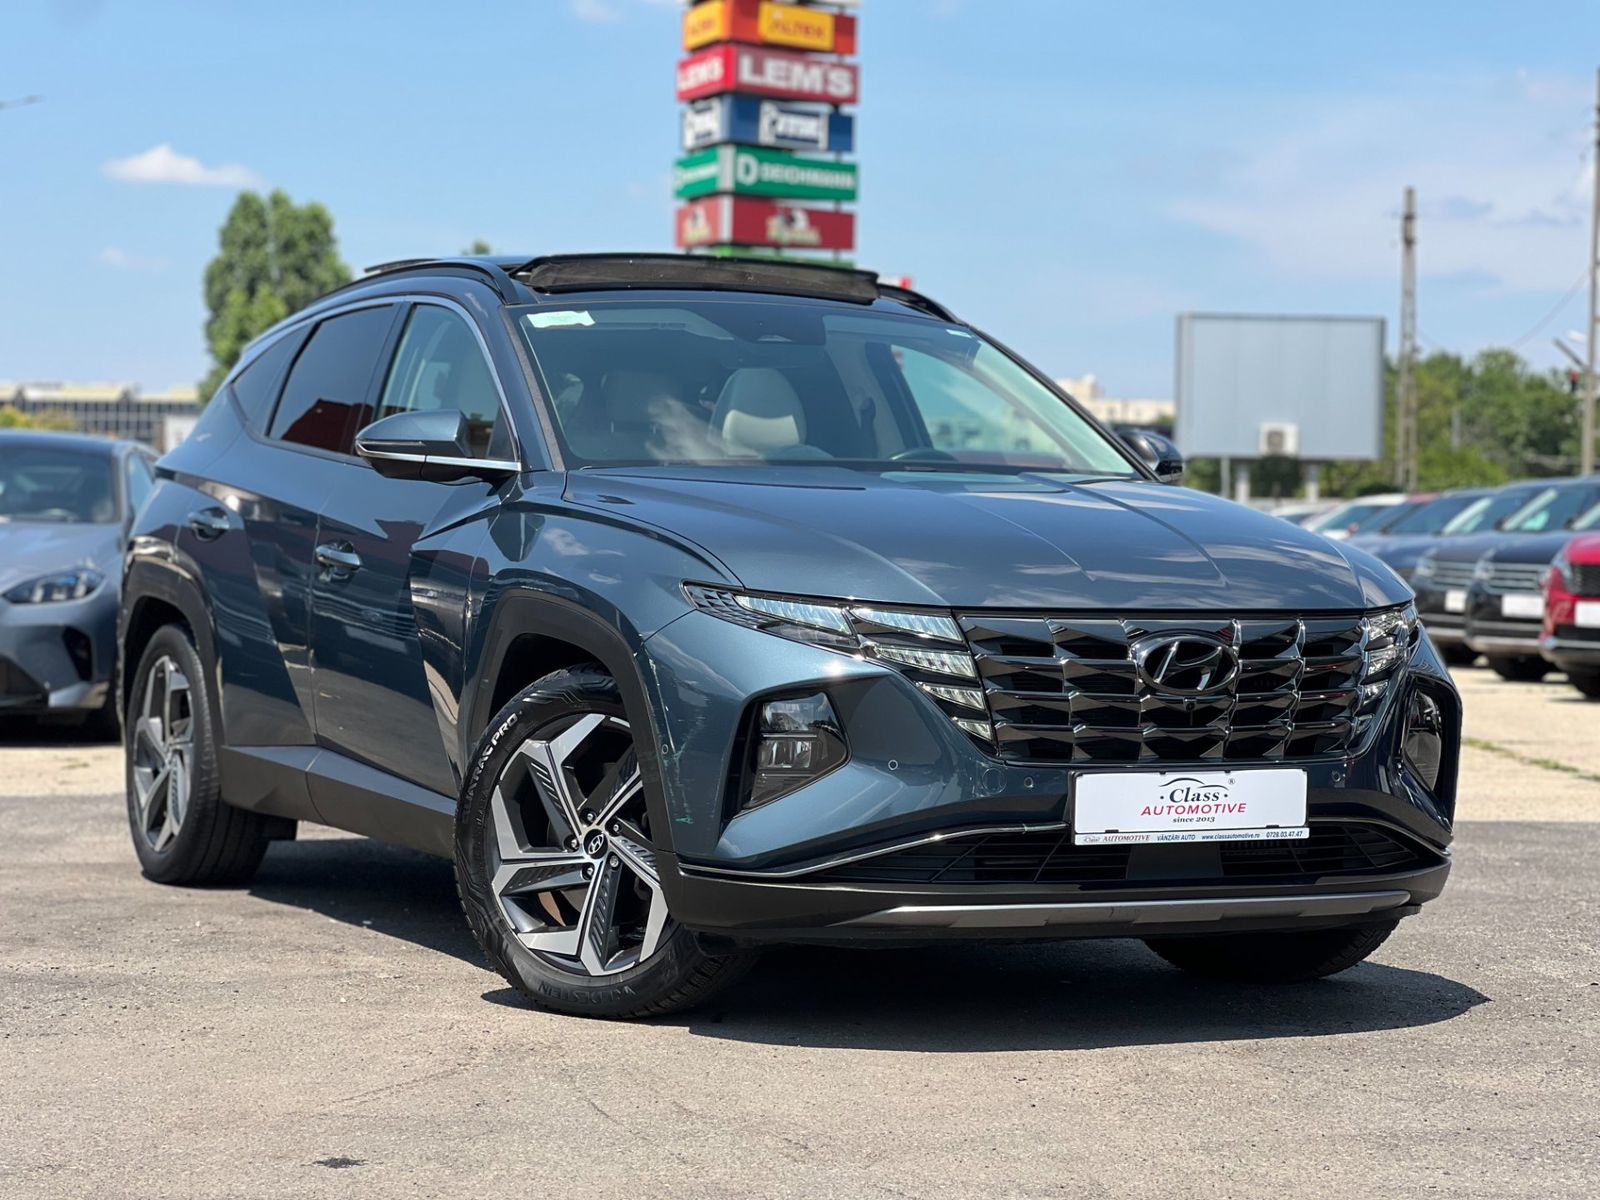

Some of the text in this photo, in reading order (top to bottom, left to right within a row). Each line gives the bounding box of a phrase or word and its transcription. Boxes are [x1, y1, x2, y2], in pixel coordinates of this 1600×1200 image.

[491, 713, 517, 746] PRO
[1169, 787, 1220, 803] Class
[1141, 803, 1246, 816] AUTOMOTIVE
